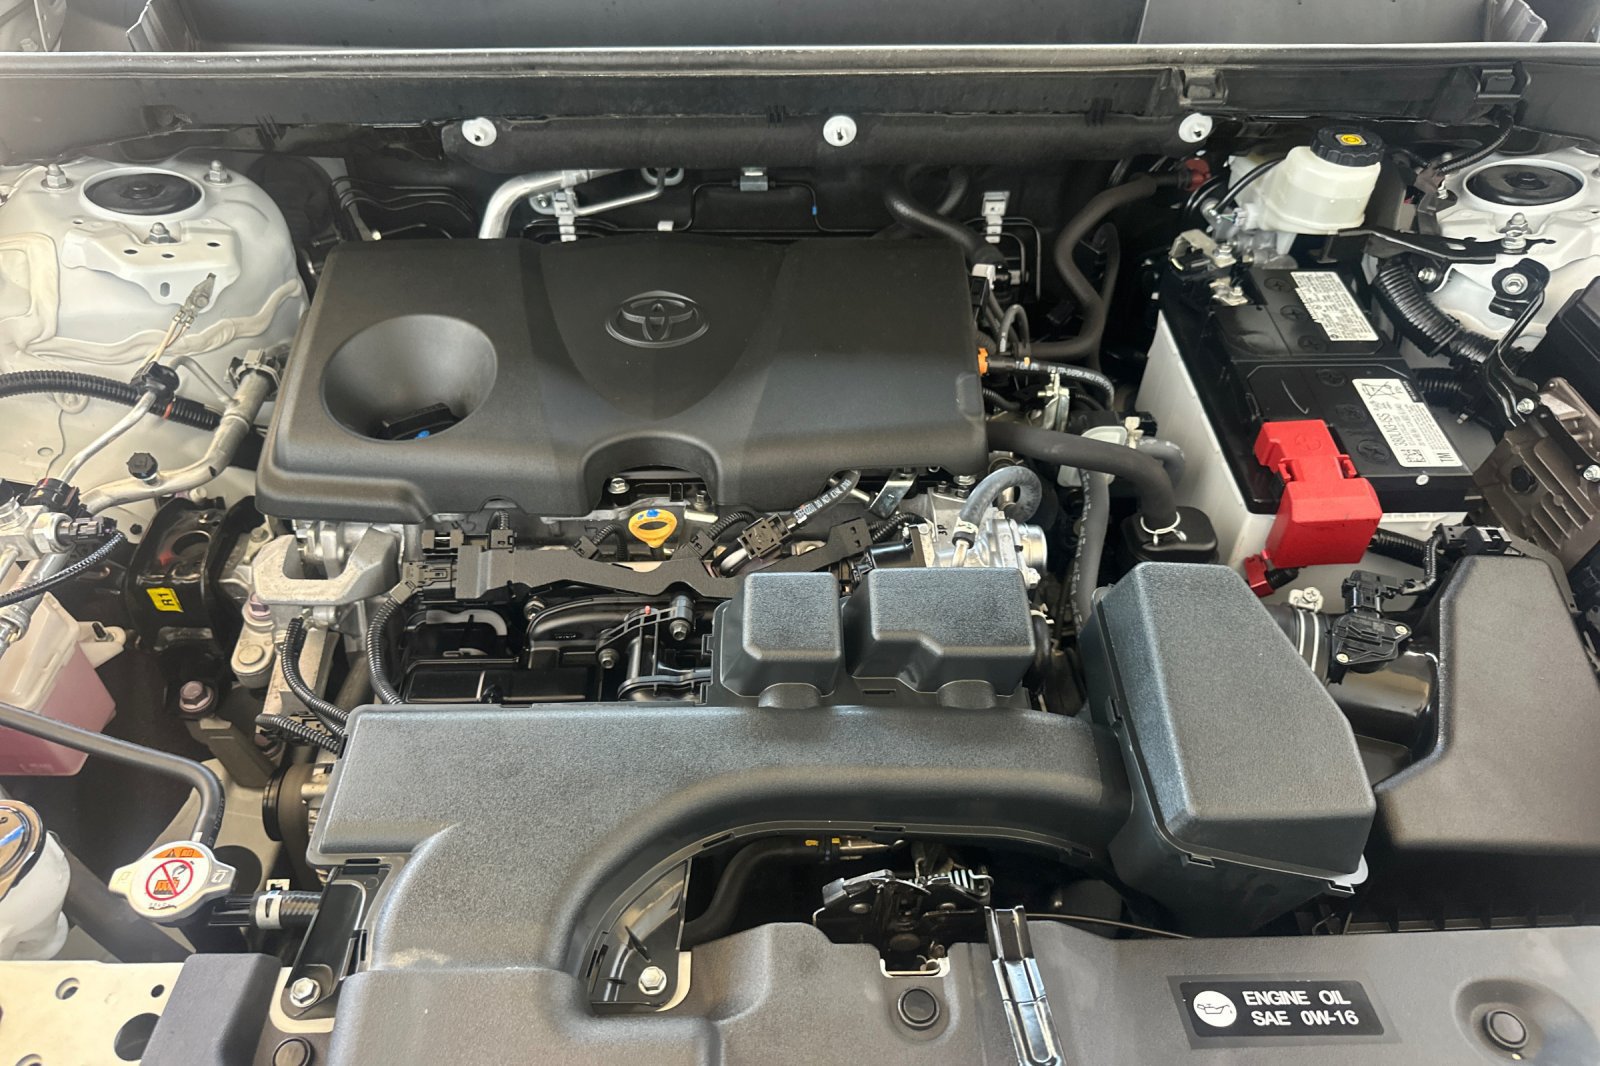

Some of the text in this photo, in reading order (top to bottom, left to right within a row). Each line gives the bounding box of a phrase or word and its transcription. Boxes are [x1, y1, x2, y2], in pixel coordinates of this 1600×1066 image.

[1436, 452, 1456, 463] TM
[1241, 990, 1352, 1006] ENGINE OIL
[1251, 1010, 1360, 1027] SAE 0W-16
